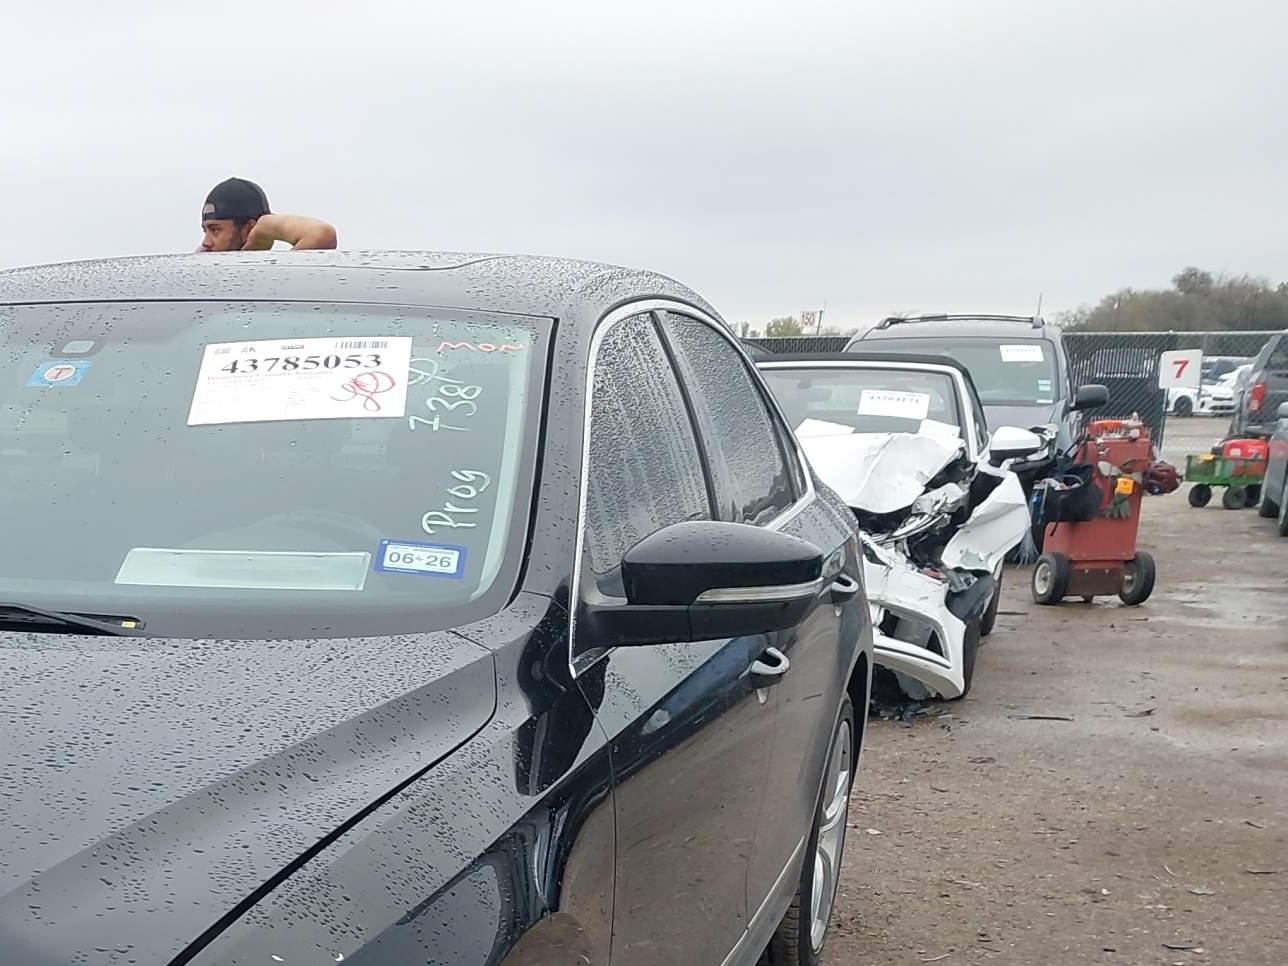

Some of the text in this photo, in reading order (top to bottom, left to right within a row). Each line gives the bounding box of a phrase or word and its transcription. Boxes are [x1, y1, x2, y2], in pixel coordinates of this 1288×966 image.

[221, 354, 382, 373] 43785053
[1173, 360, 1190, 379] 7
[422, 470, 490, 534] Prog
